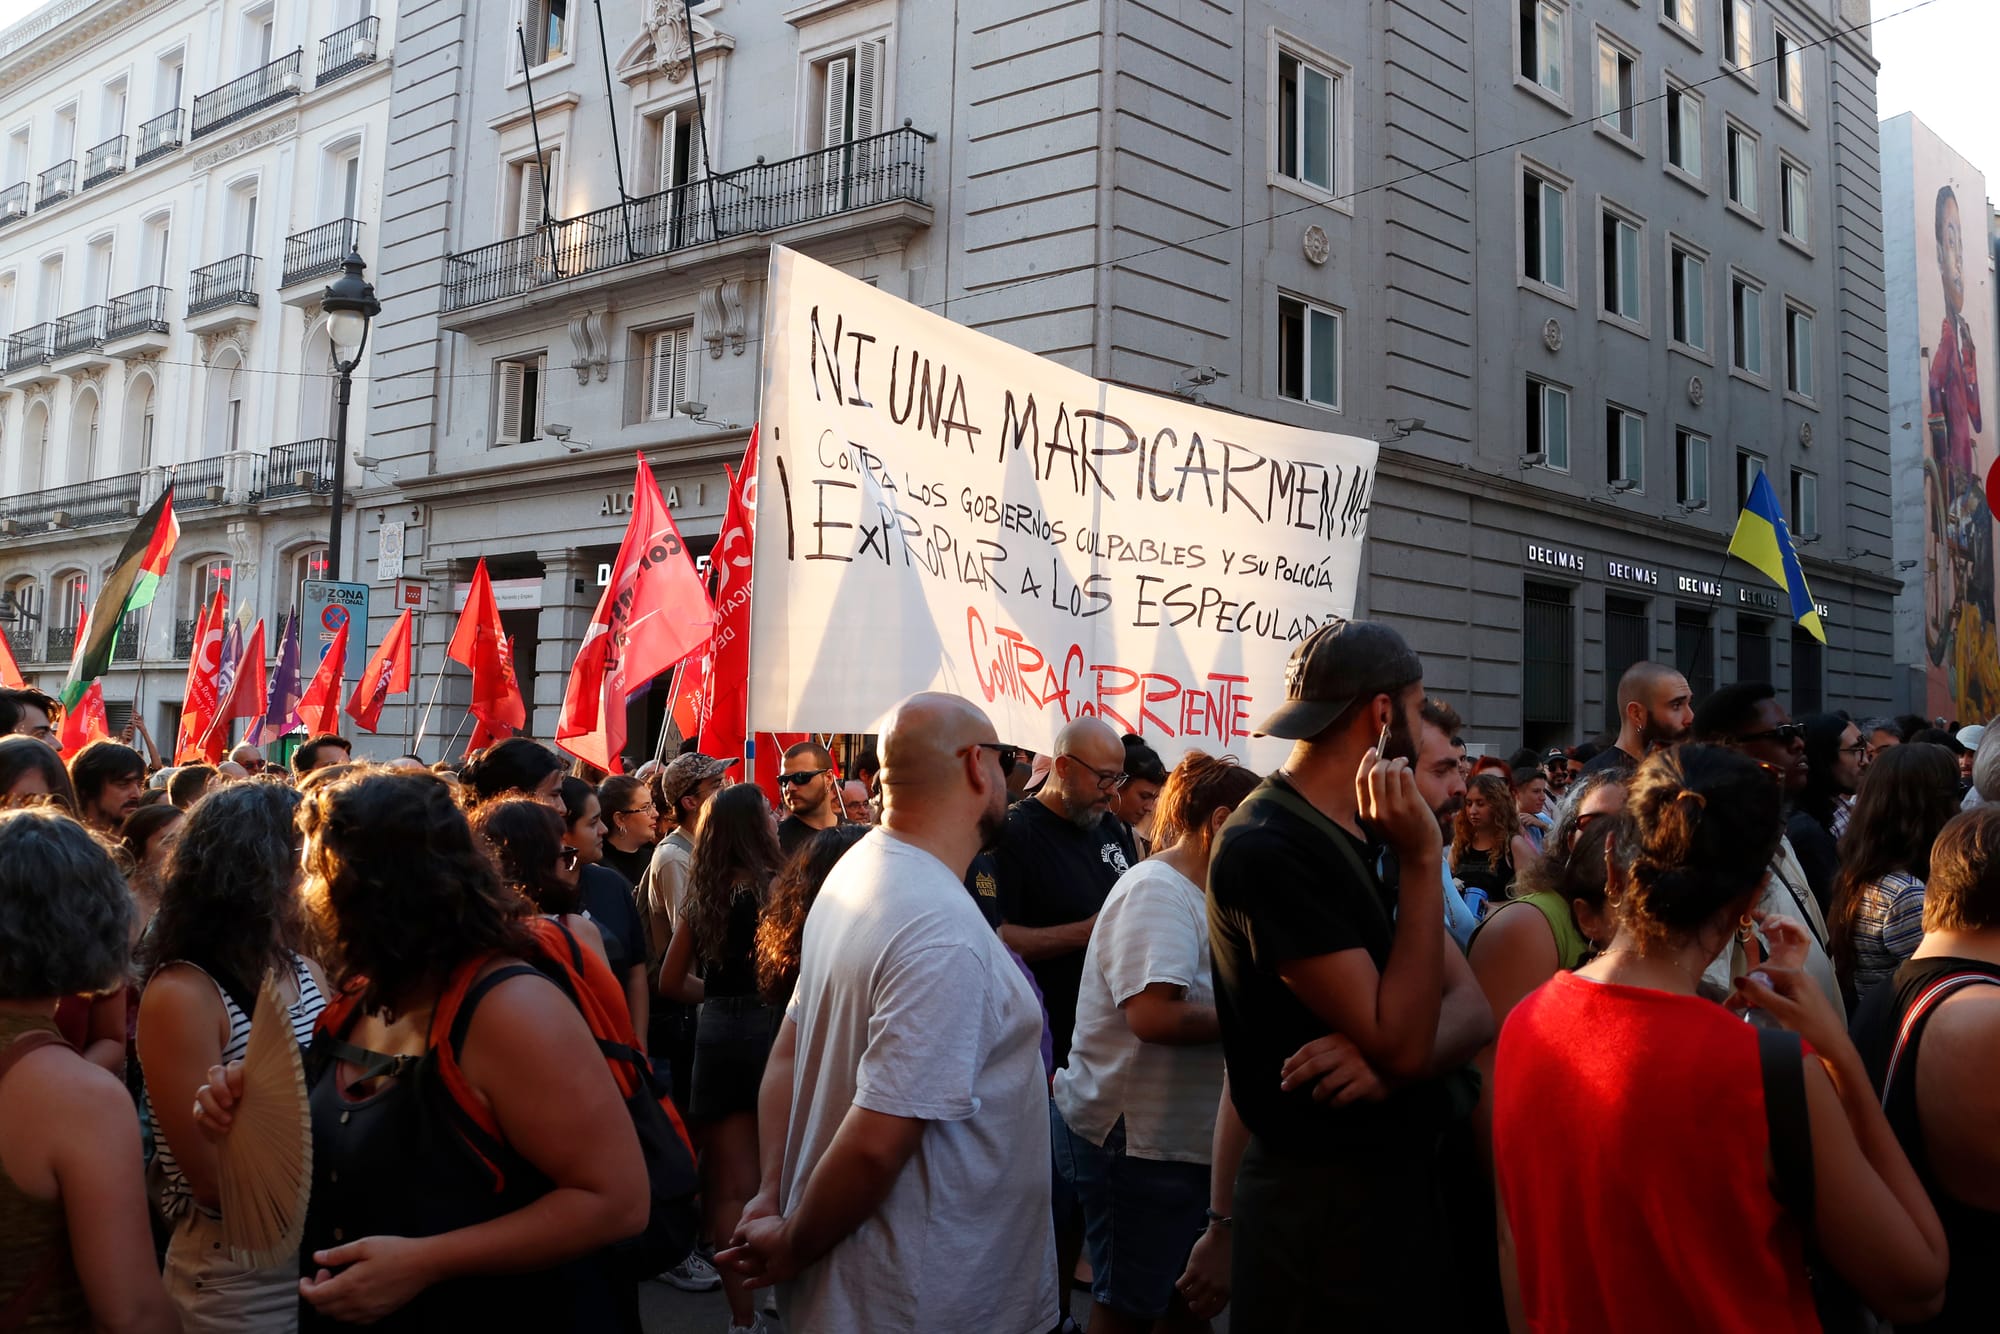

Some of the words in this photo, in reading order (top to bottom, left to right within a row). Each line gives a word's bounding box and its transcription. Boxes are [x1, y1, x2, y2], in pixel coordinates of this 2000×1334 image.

[810, 304, 877, 409] NI
[888, 344, 982, 455] UNA
[998, 388, 1342, 542] MARICARMEN
[598, 485, 681, 516] ALCA
[905, 471, 948, 508] LOS
[960, 486, 1067, 546] GOBIERNOS
[1076, 526, 1207, 569] CULPABLES
[1222, 549, 1236, 576] Y
[1528, 544, 1584, 571] DECIMAS
[1609, 561, 1658, 585] DECIMAS
[1678, 576, 1722, 597] DECIMAS
[327, 588, 364, 600] ZONA
[1020, 566, 1042, 599] A
[1052, 557, 1113, 618] LOS
[1132, 573, 1340, 642] ESPECULAD
[1740, 588, 1778, 609] DECIMAS
